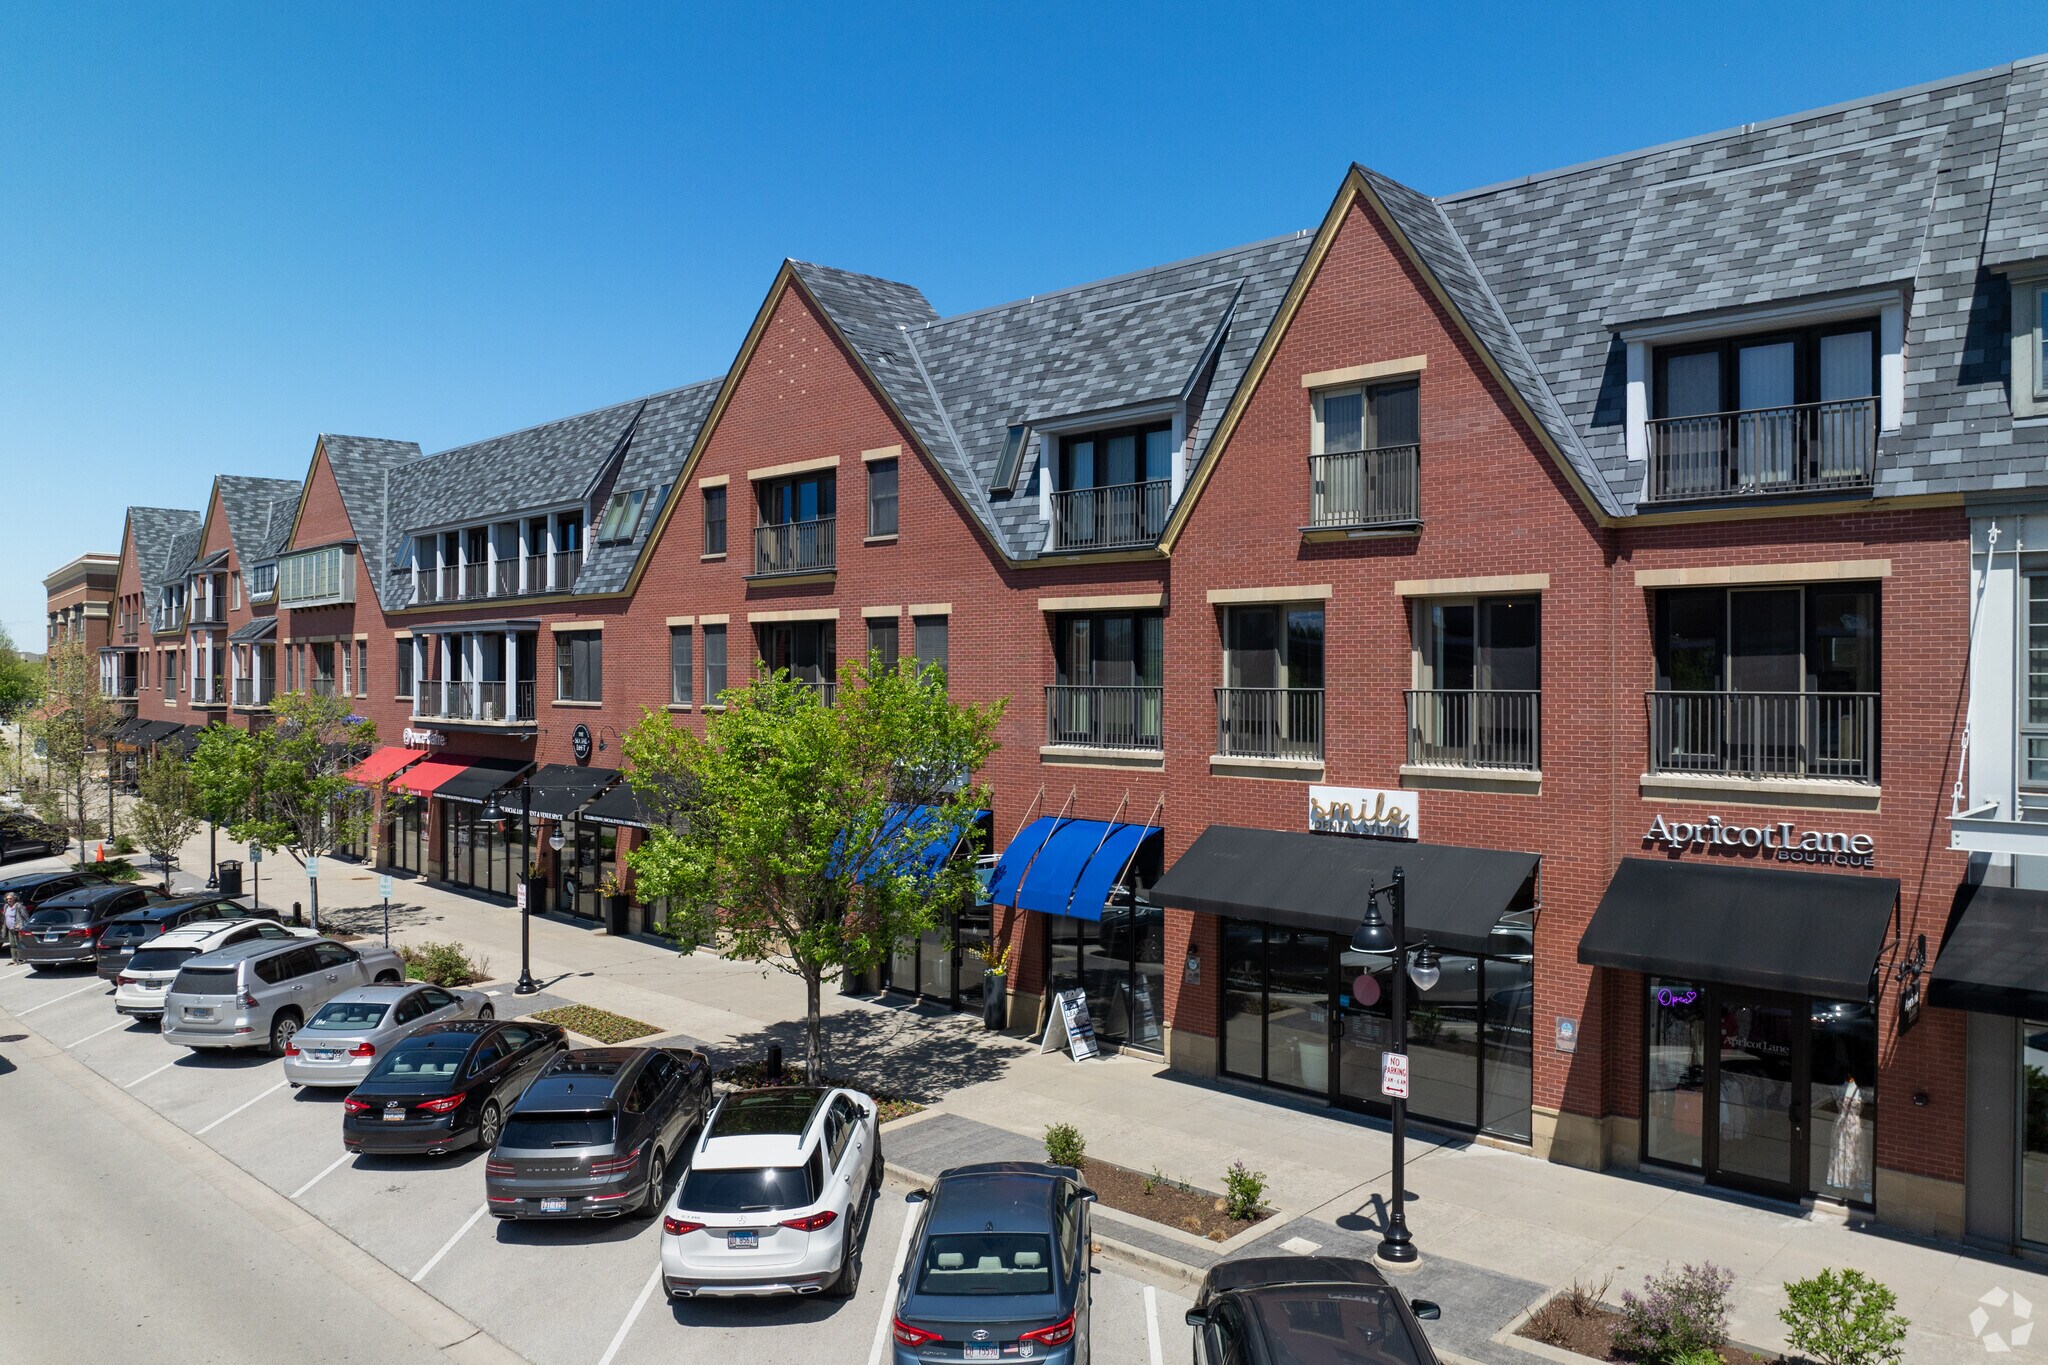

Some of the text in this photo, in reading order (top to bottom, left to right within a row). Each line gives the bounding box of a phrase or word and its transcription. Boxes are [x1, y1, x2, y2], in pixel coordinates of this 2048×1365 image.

[1310, 792, 1410, 824] smile
[1314, 820, 1410, 838] DENTAL STUDIO
[1643, 814, 1874, 854] Apricot Lane
[1778, 850, 1874, 867] BOUTIQUE
[1658, 988, 1691, 1007] Open
[1723, 1036, 1762, 1048] Apricot
[1763, 1042, 1789, 1053] Lane
[1390, 1057, 1400, 1066] NO
[1384, 1066, 1406, 1076] PARKING
